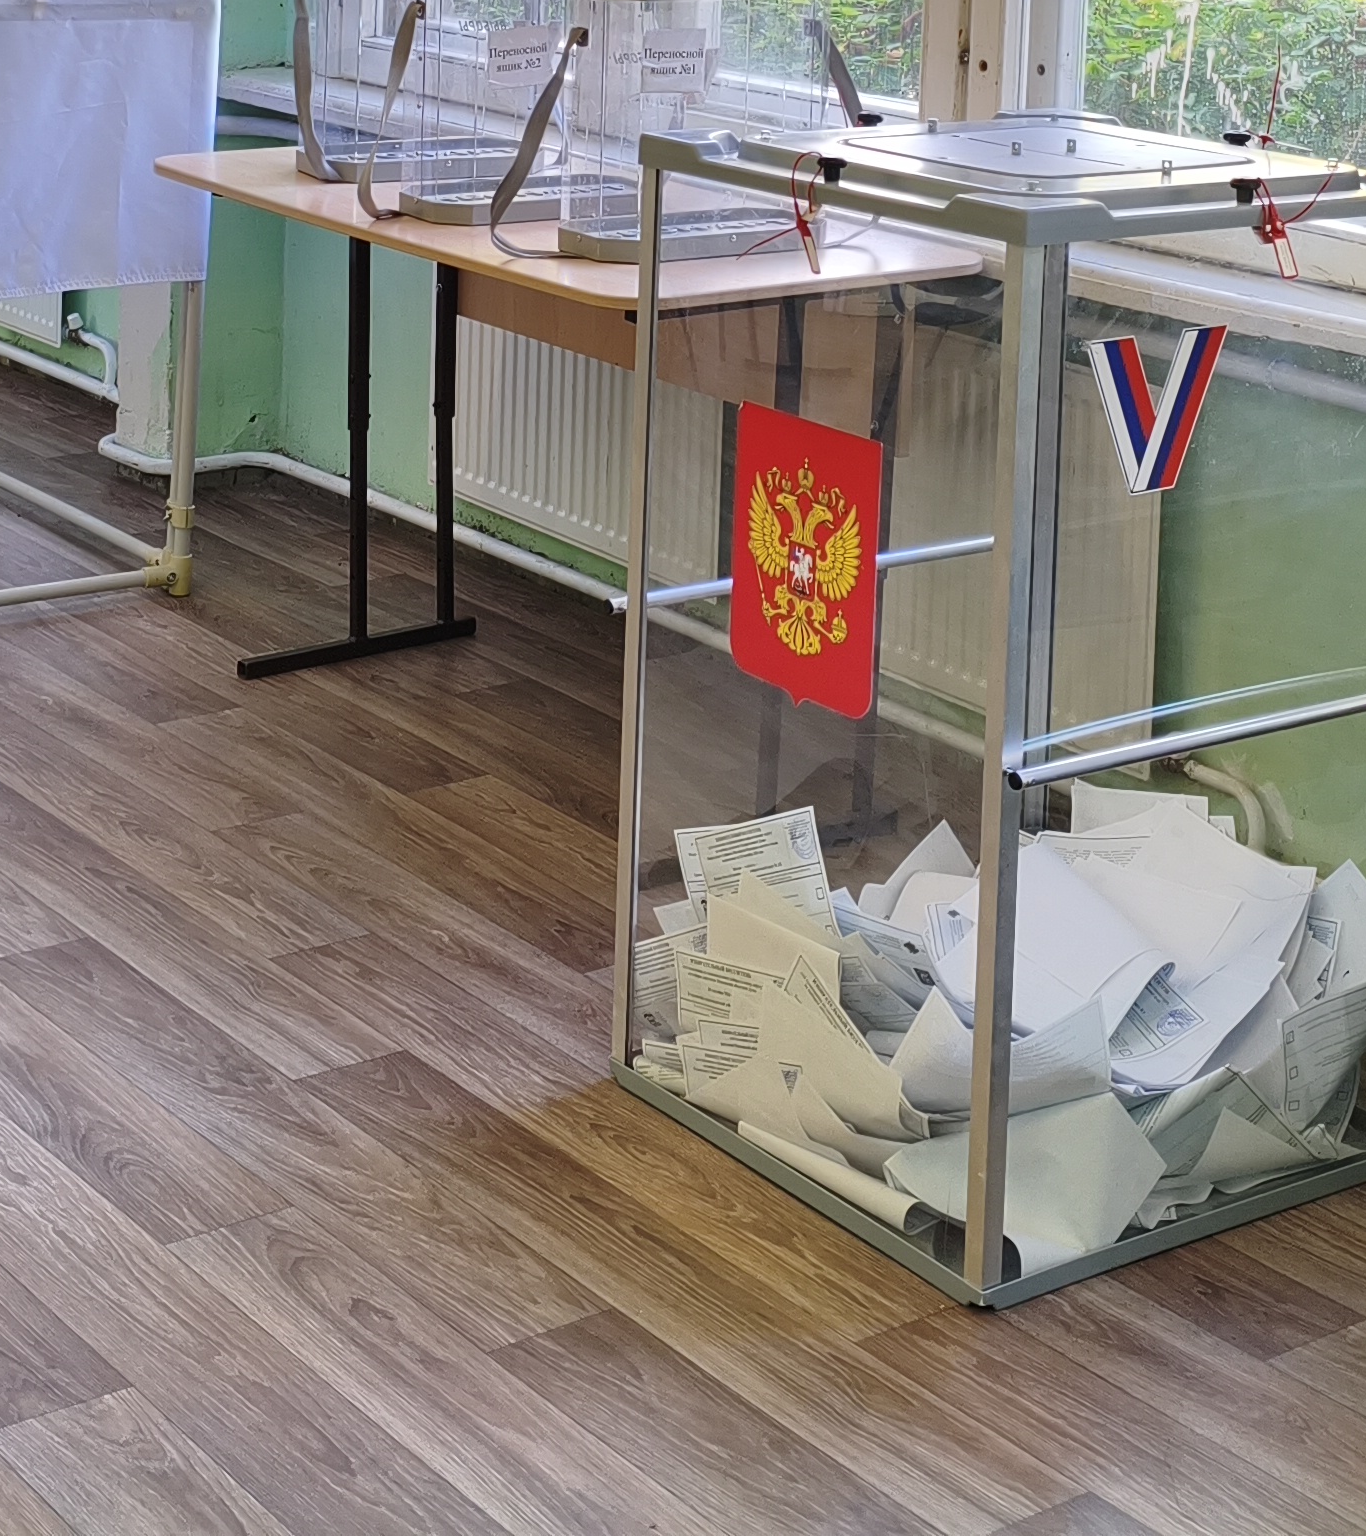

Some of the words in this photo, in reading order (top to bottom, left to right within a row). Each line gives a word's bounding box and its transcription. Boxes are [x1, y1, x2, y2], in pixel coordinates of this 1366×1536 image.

[489, 42, 548, 59] Переносной
[644, 48, 704, 62] Переносной
[496, 62, 523, 73] ящик
[524, 58, 541, 69] №2
[650, 66, 677, 76] ящик
[678, 64, 695, 74] №1
